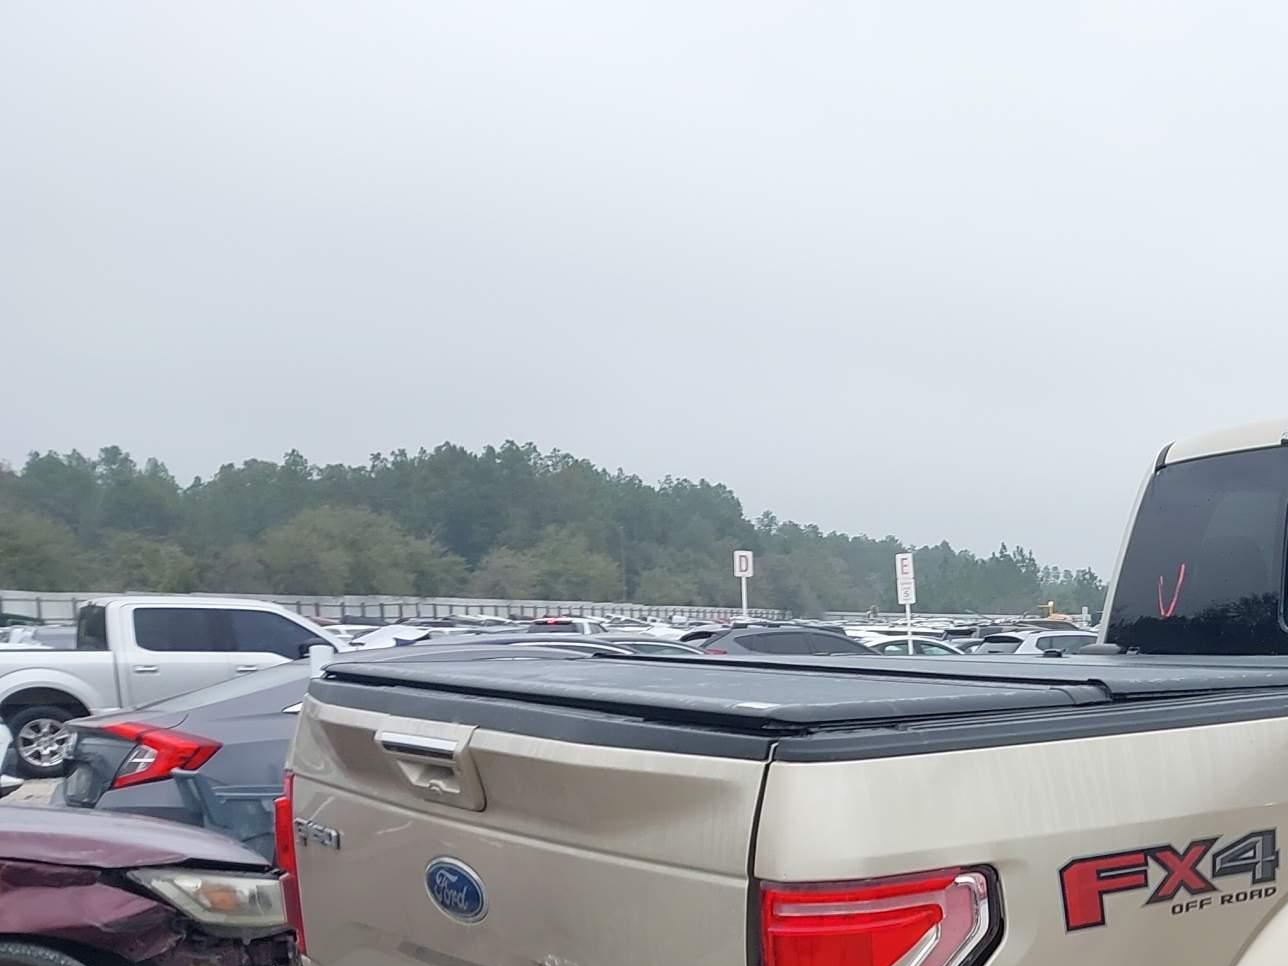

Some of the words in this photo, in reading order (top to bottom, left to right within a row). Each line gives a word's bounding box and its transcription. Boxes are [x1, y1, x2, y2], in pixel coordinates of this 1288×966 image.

[739, 555, 748, 572] D
[901, 558, 909, 575] E
[434, 869, 468, 910] Ford
[1059, 828, 1279, 932] FX4
[1171, 899, 1212, 915] OFF
[1220, 886, 1277, 906] ROAD
